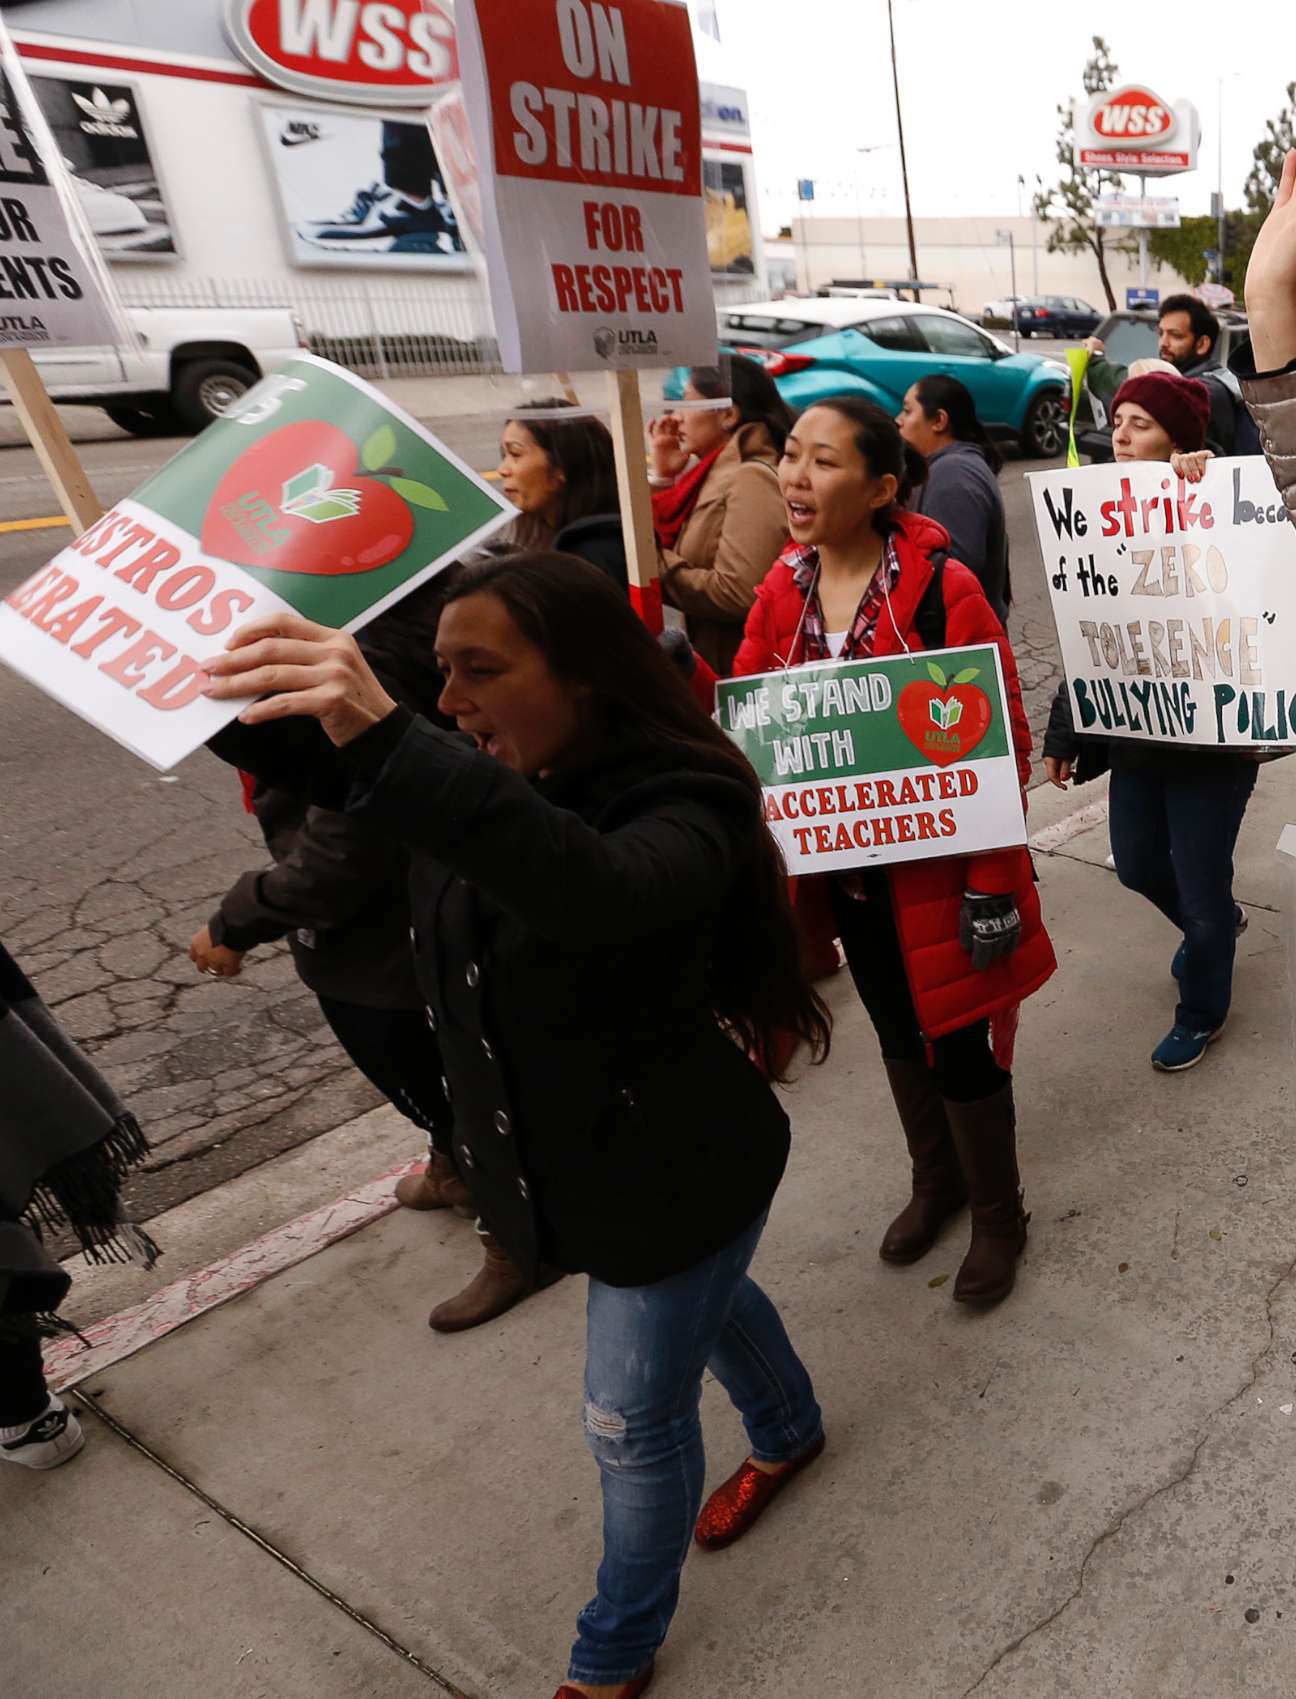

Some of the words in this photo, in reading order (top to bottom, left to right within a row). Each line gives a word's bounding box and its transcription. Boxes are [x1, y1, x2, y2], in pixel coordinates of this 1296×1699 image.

[279, 0, 454, 78] WSS
[556, 0, 631, 87] ON
[510, 81, 684, 182] STRIKE
[1101, 104, 1164, 134] WSS
[583, 200, 644, 253] FOR
[552, 264, 684, 314] RESPECT
[619, 330, 657, 344] UTLA
[1043, 488, 1088, 540] We
[1100, 476, 1215, 537] strike
[1052, 556, 1068, 592] of
[1077, 554, 1119, 597] the
[727, 687, 771, 731] WE
[781, 673, 892, 723] STAND
[1073, 678, 1197, 737] BULLYING
[773, 730, 856, 776] WITH
[925, 731, 960, 743] UTLA
[766, 769, 979, 823] ACCELERATED
[793, 808, 957, 856] TEACHERS
